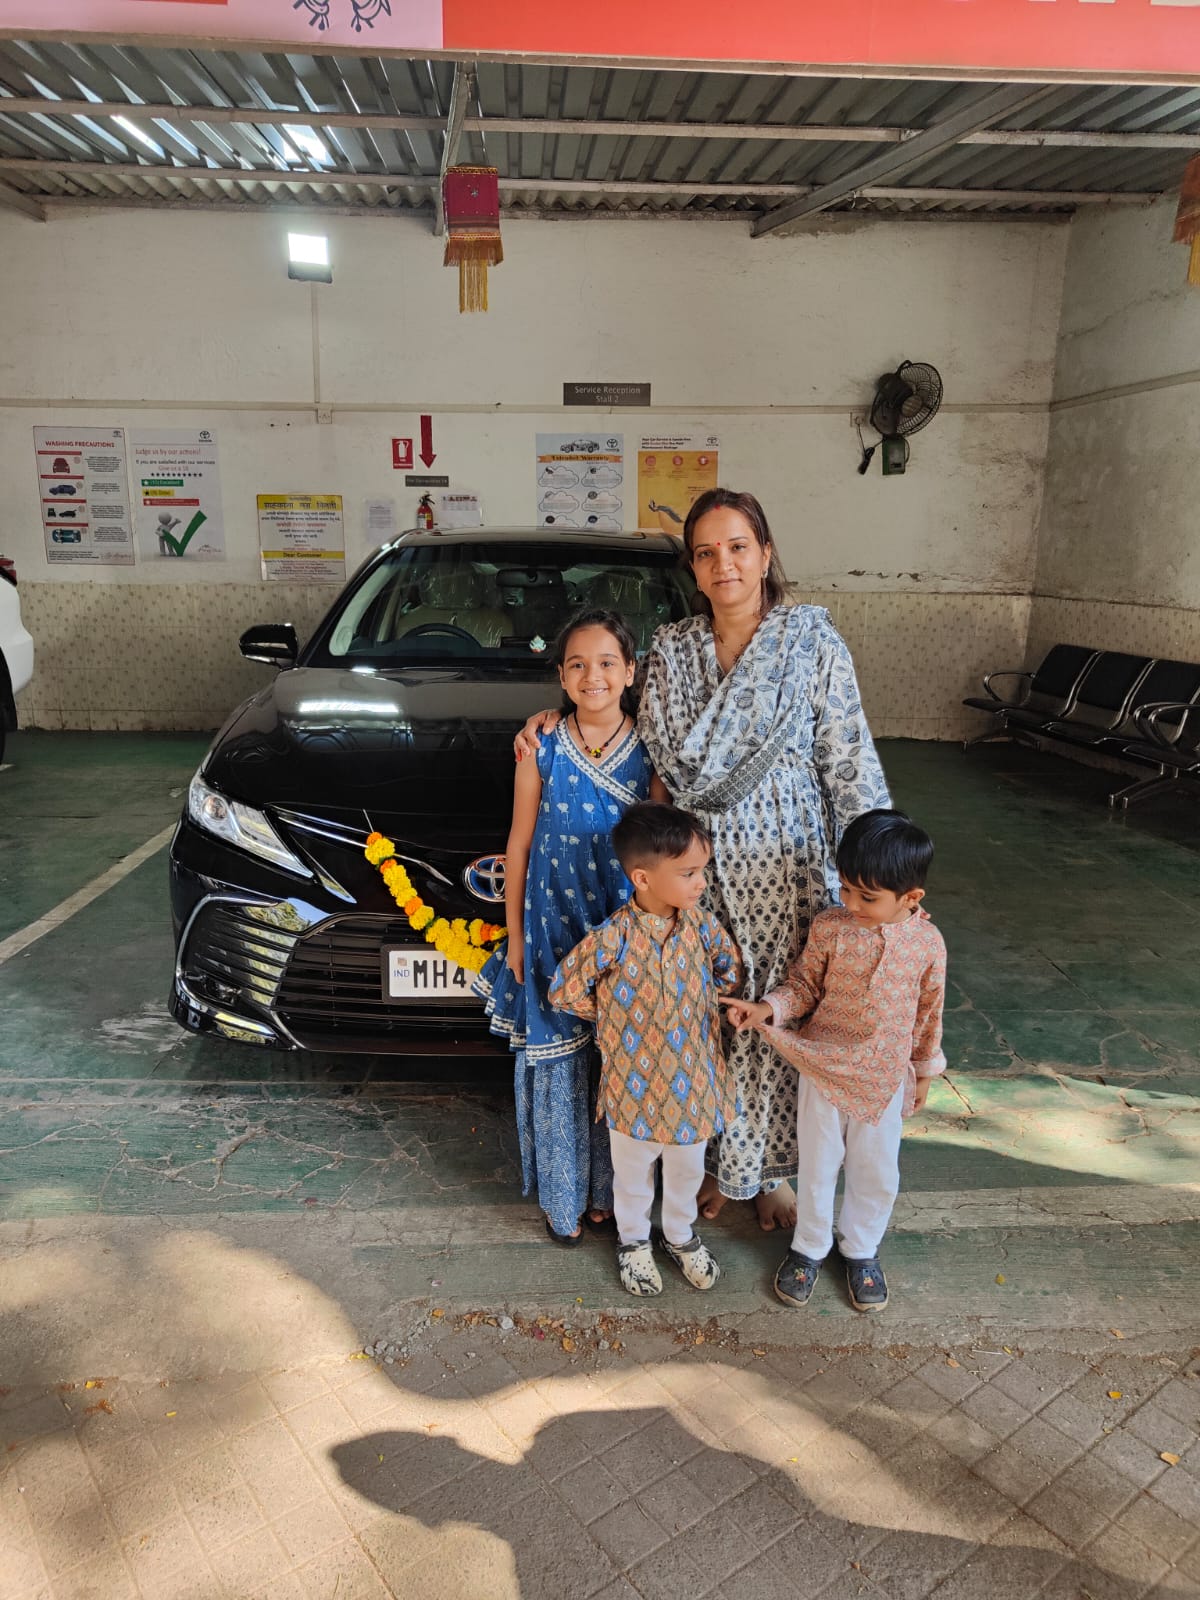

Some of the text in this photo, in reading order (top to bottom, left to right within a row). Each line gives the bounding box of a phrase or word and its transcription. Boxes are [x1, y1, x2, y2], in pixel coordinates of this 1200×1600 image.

[574, 385, 641, 396] Service Reception
[595, 395, 612, 403] Stall
[393, 969, 410, 978] IND
